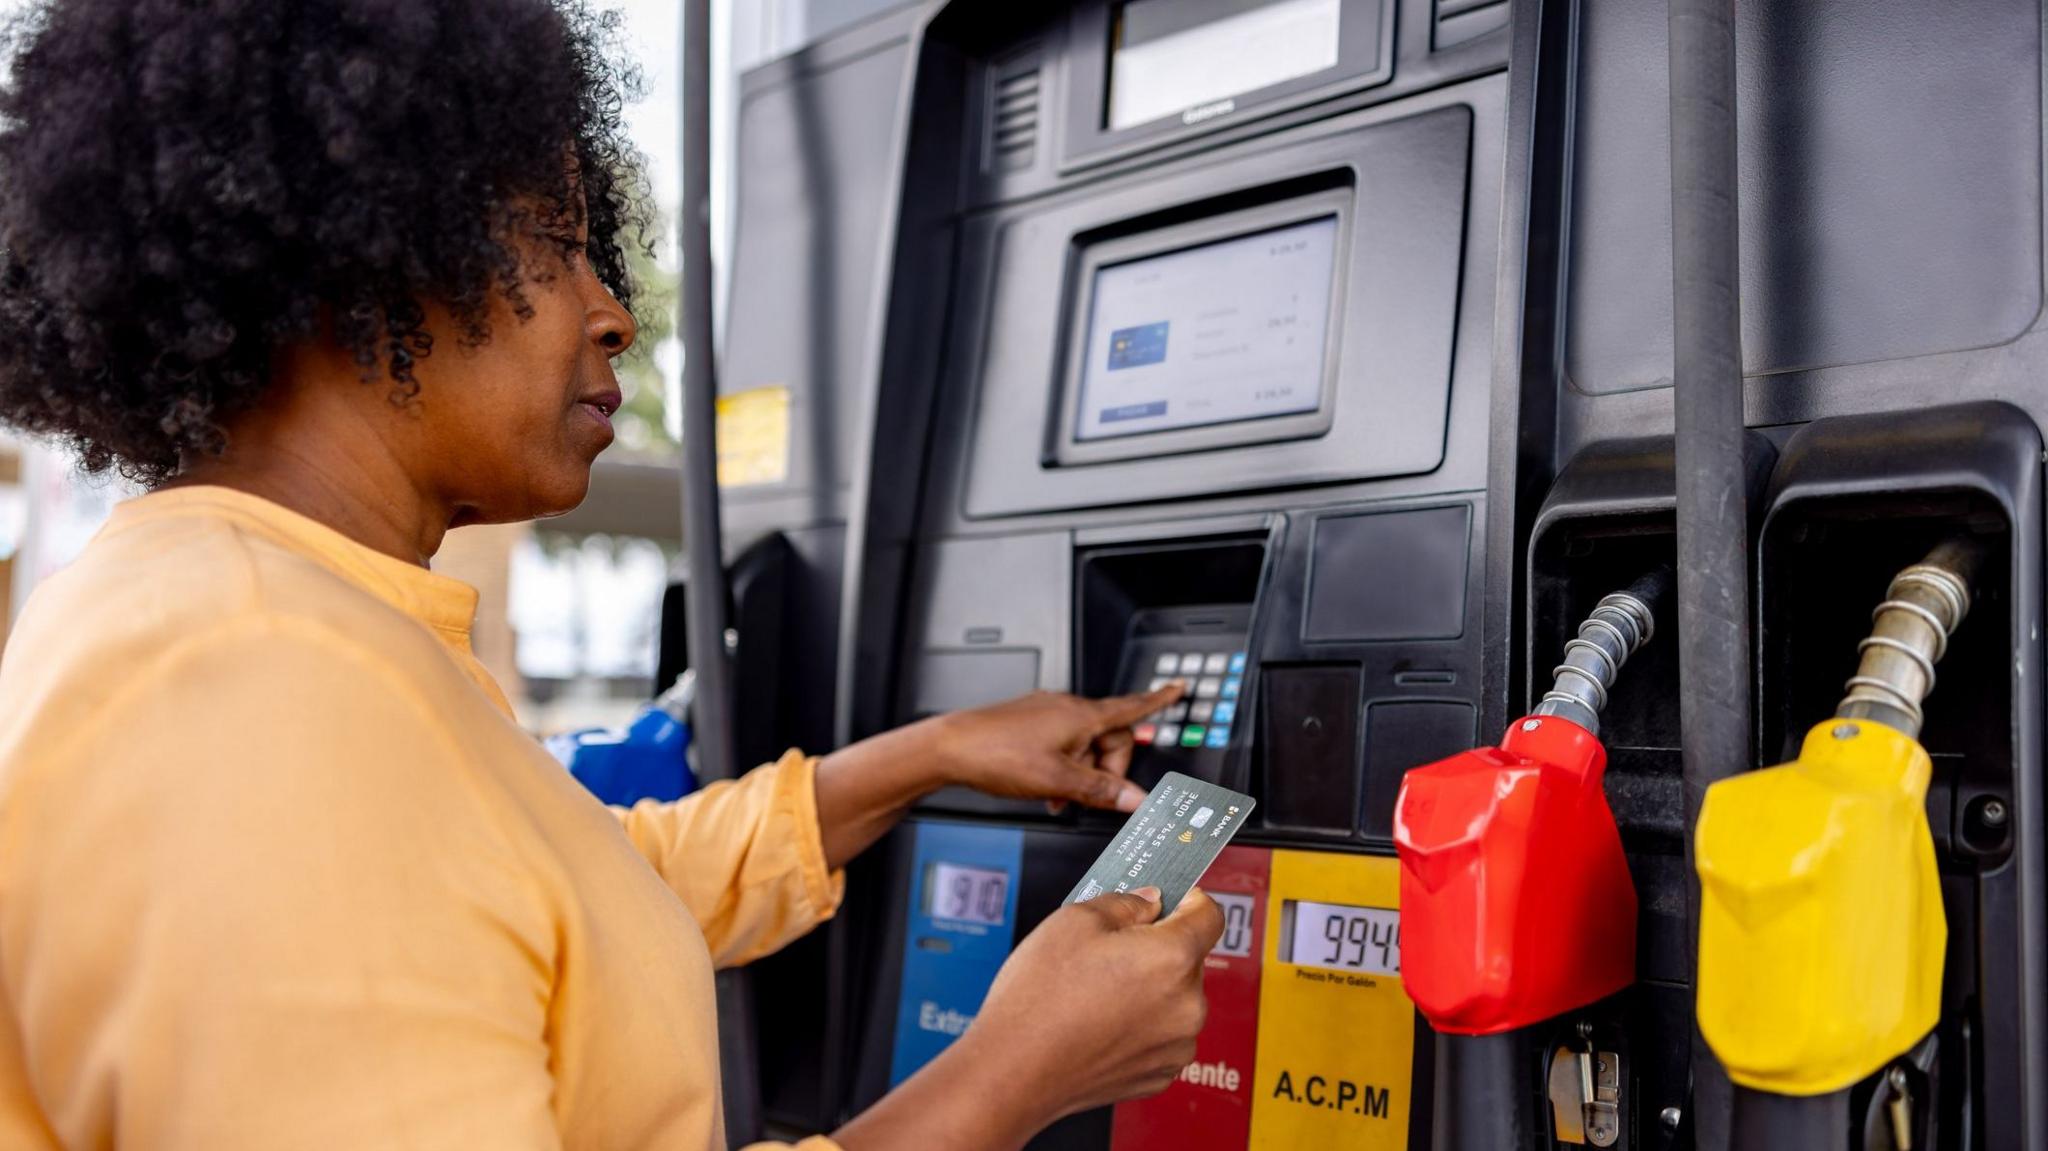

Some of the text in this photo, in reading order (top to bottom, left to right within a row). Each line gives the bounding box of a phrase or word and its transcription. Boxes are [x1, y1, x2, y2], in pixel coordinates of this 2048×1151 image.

[1155, 784, 1173, 804] JUAN
[1174, 791, 1198, 817] 3400
[1116, 816, 1149, 855] MARTINEZ
[1150, 822, 1175, 847] 7655
[1209, 814, 1232, 838] BANK
[1126, 851, 1152, 877] 1100
[1296, 968, 1325, 982] Precio
[1328, 972, 1345, 984] Por
[1273, 1070, 1390, 1120] A.C.P.M
